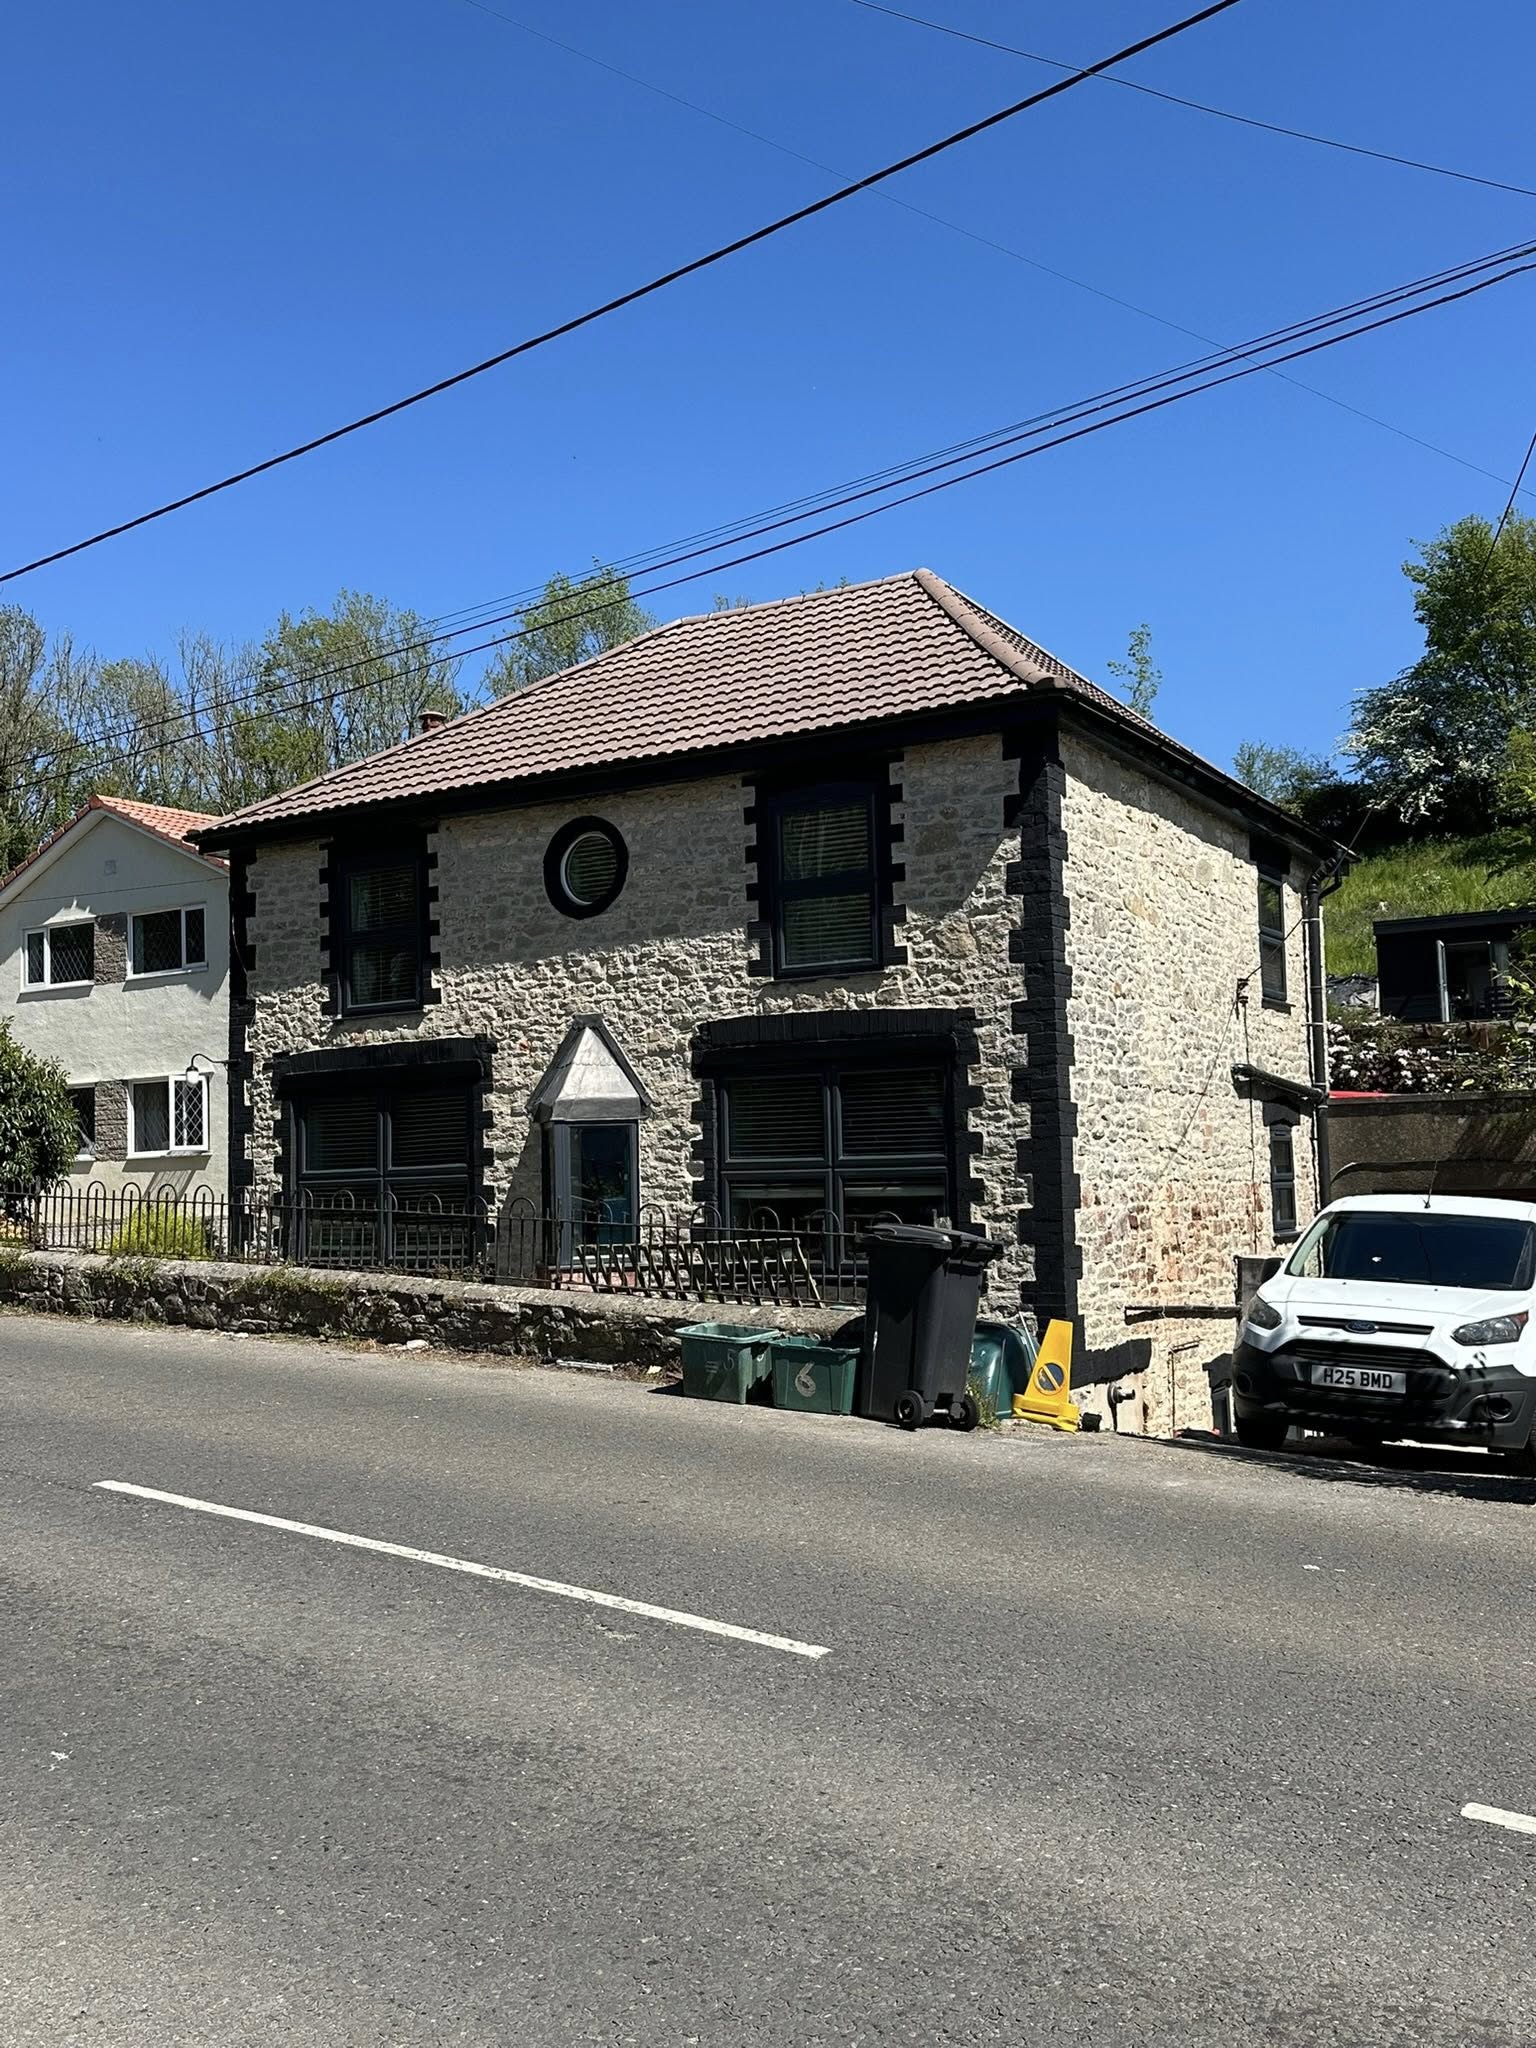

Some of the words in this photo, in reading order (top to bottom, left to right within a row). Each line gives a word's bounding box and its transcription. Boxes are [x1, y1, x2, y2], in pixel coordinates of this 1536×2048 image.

[795, 1361, 816, 1397] 6
[1324, 1368, 1355, 1385] H25
[1359, 1372, 1392, 1389] BMD
